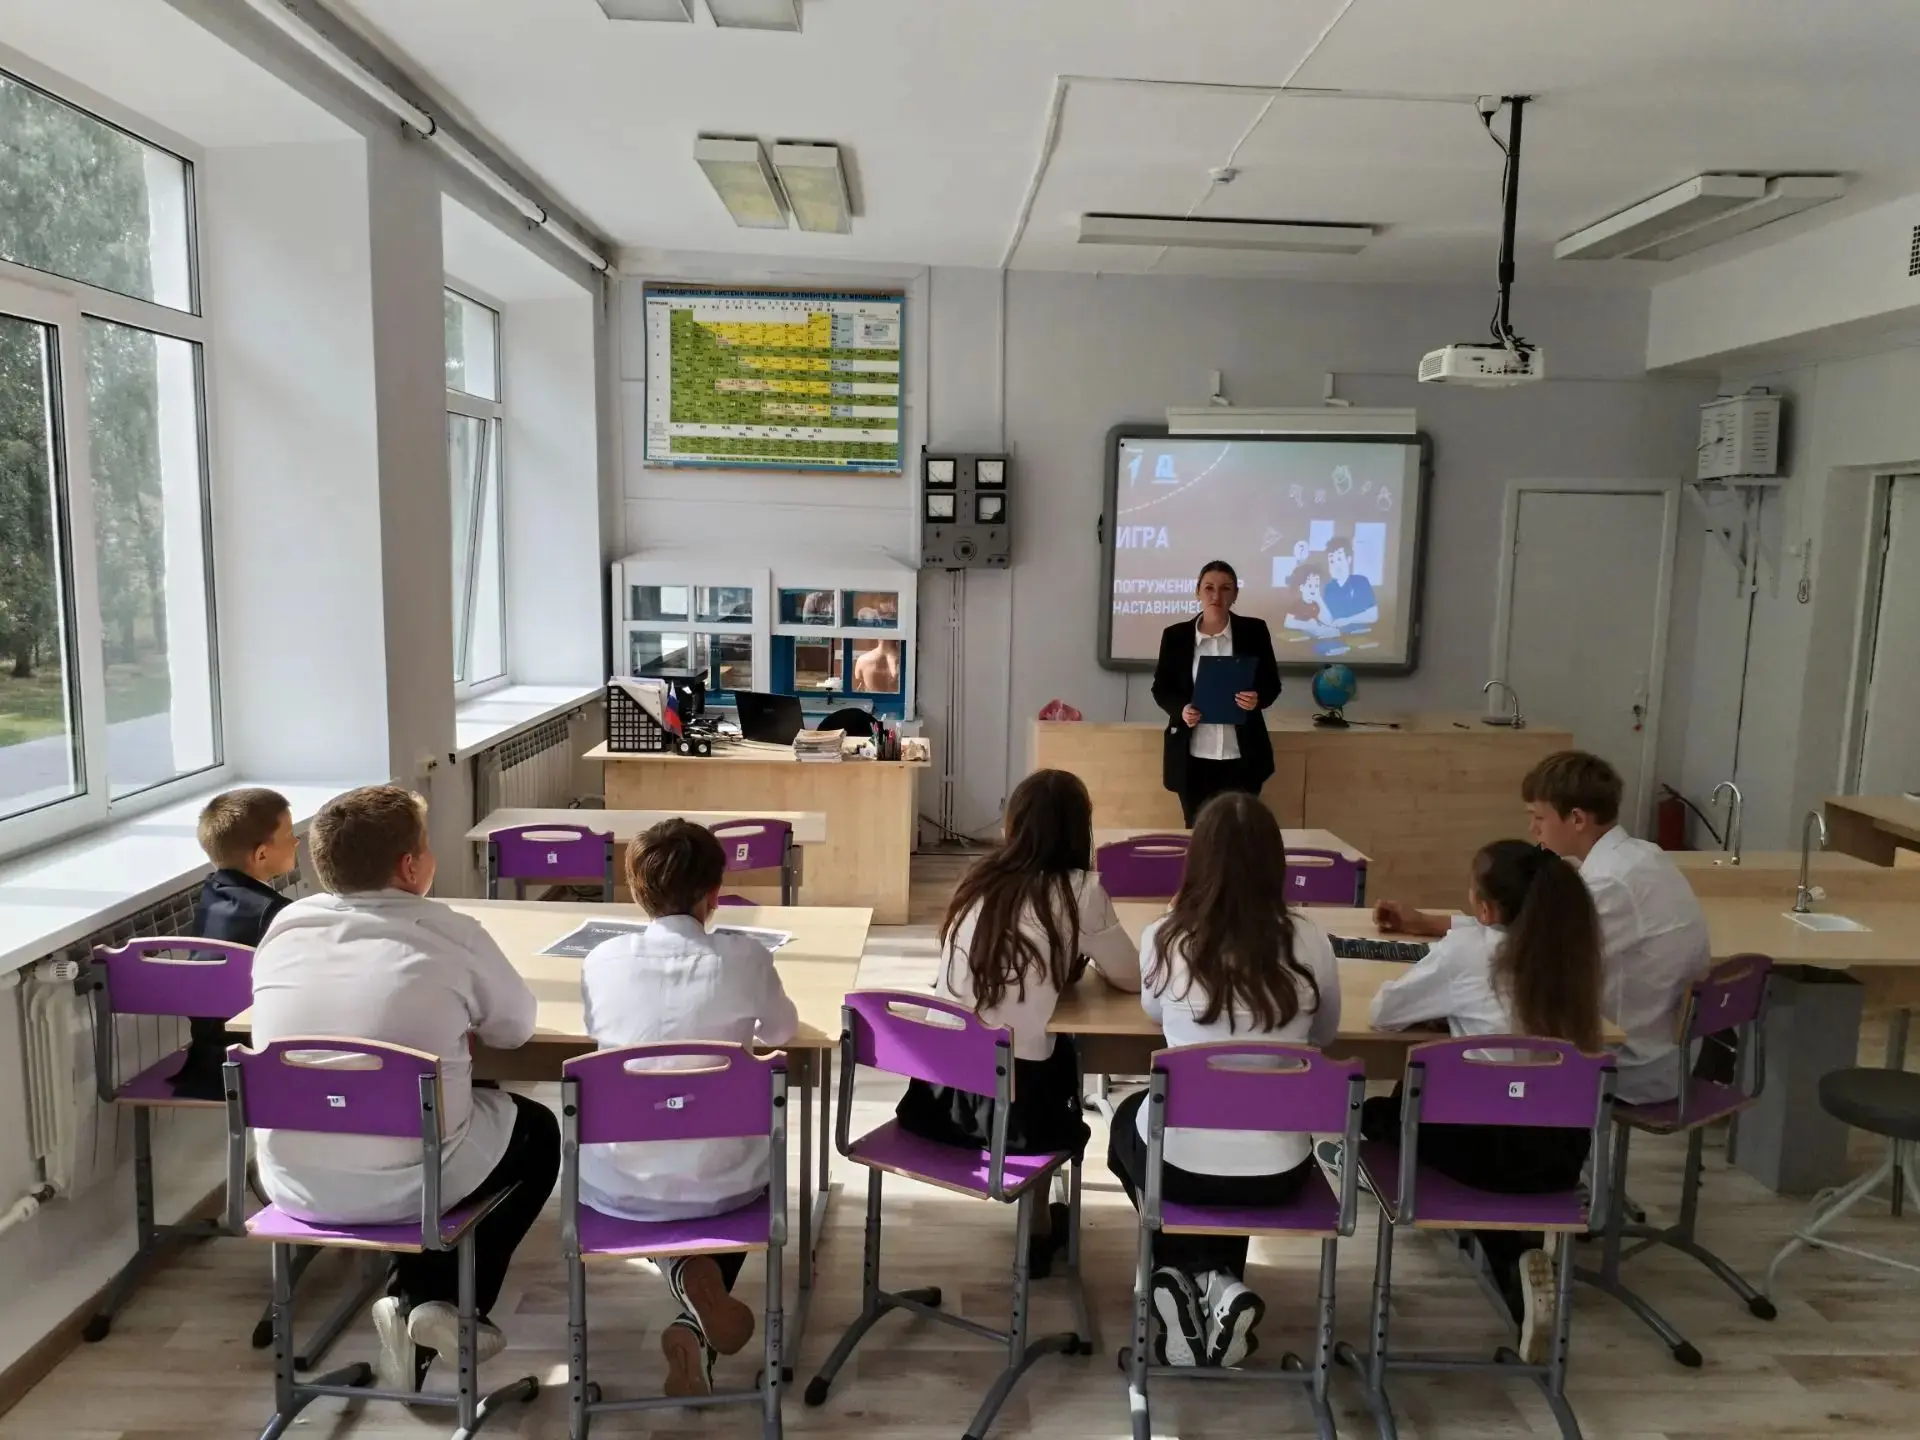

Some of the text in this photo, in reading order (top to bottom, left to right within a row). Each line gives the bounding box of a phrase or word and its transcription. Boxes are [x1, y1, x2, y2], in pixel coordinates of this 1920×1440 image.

[1116, 526, 1169, 548] ИГРА
[1113, 600, 1203, 615] НАСТАВНИЧЕС
[738, 848, 745, 857] 5
[1510, 1085, 1517, 1094] 6
